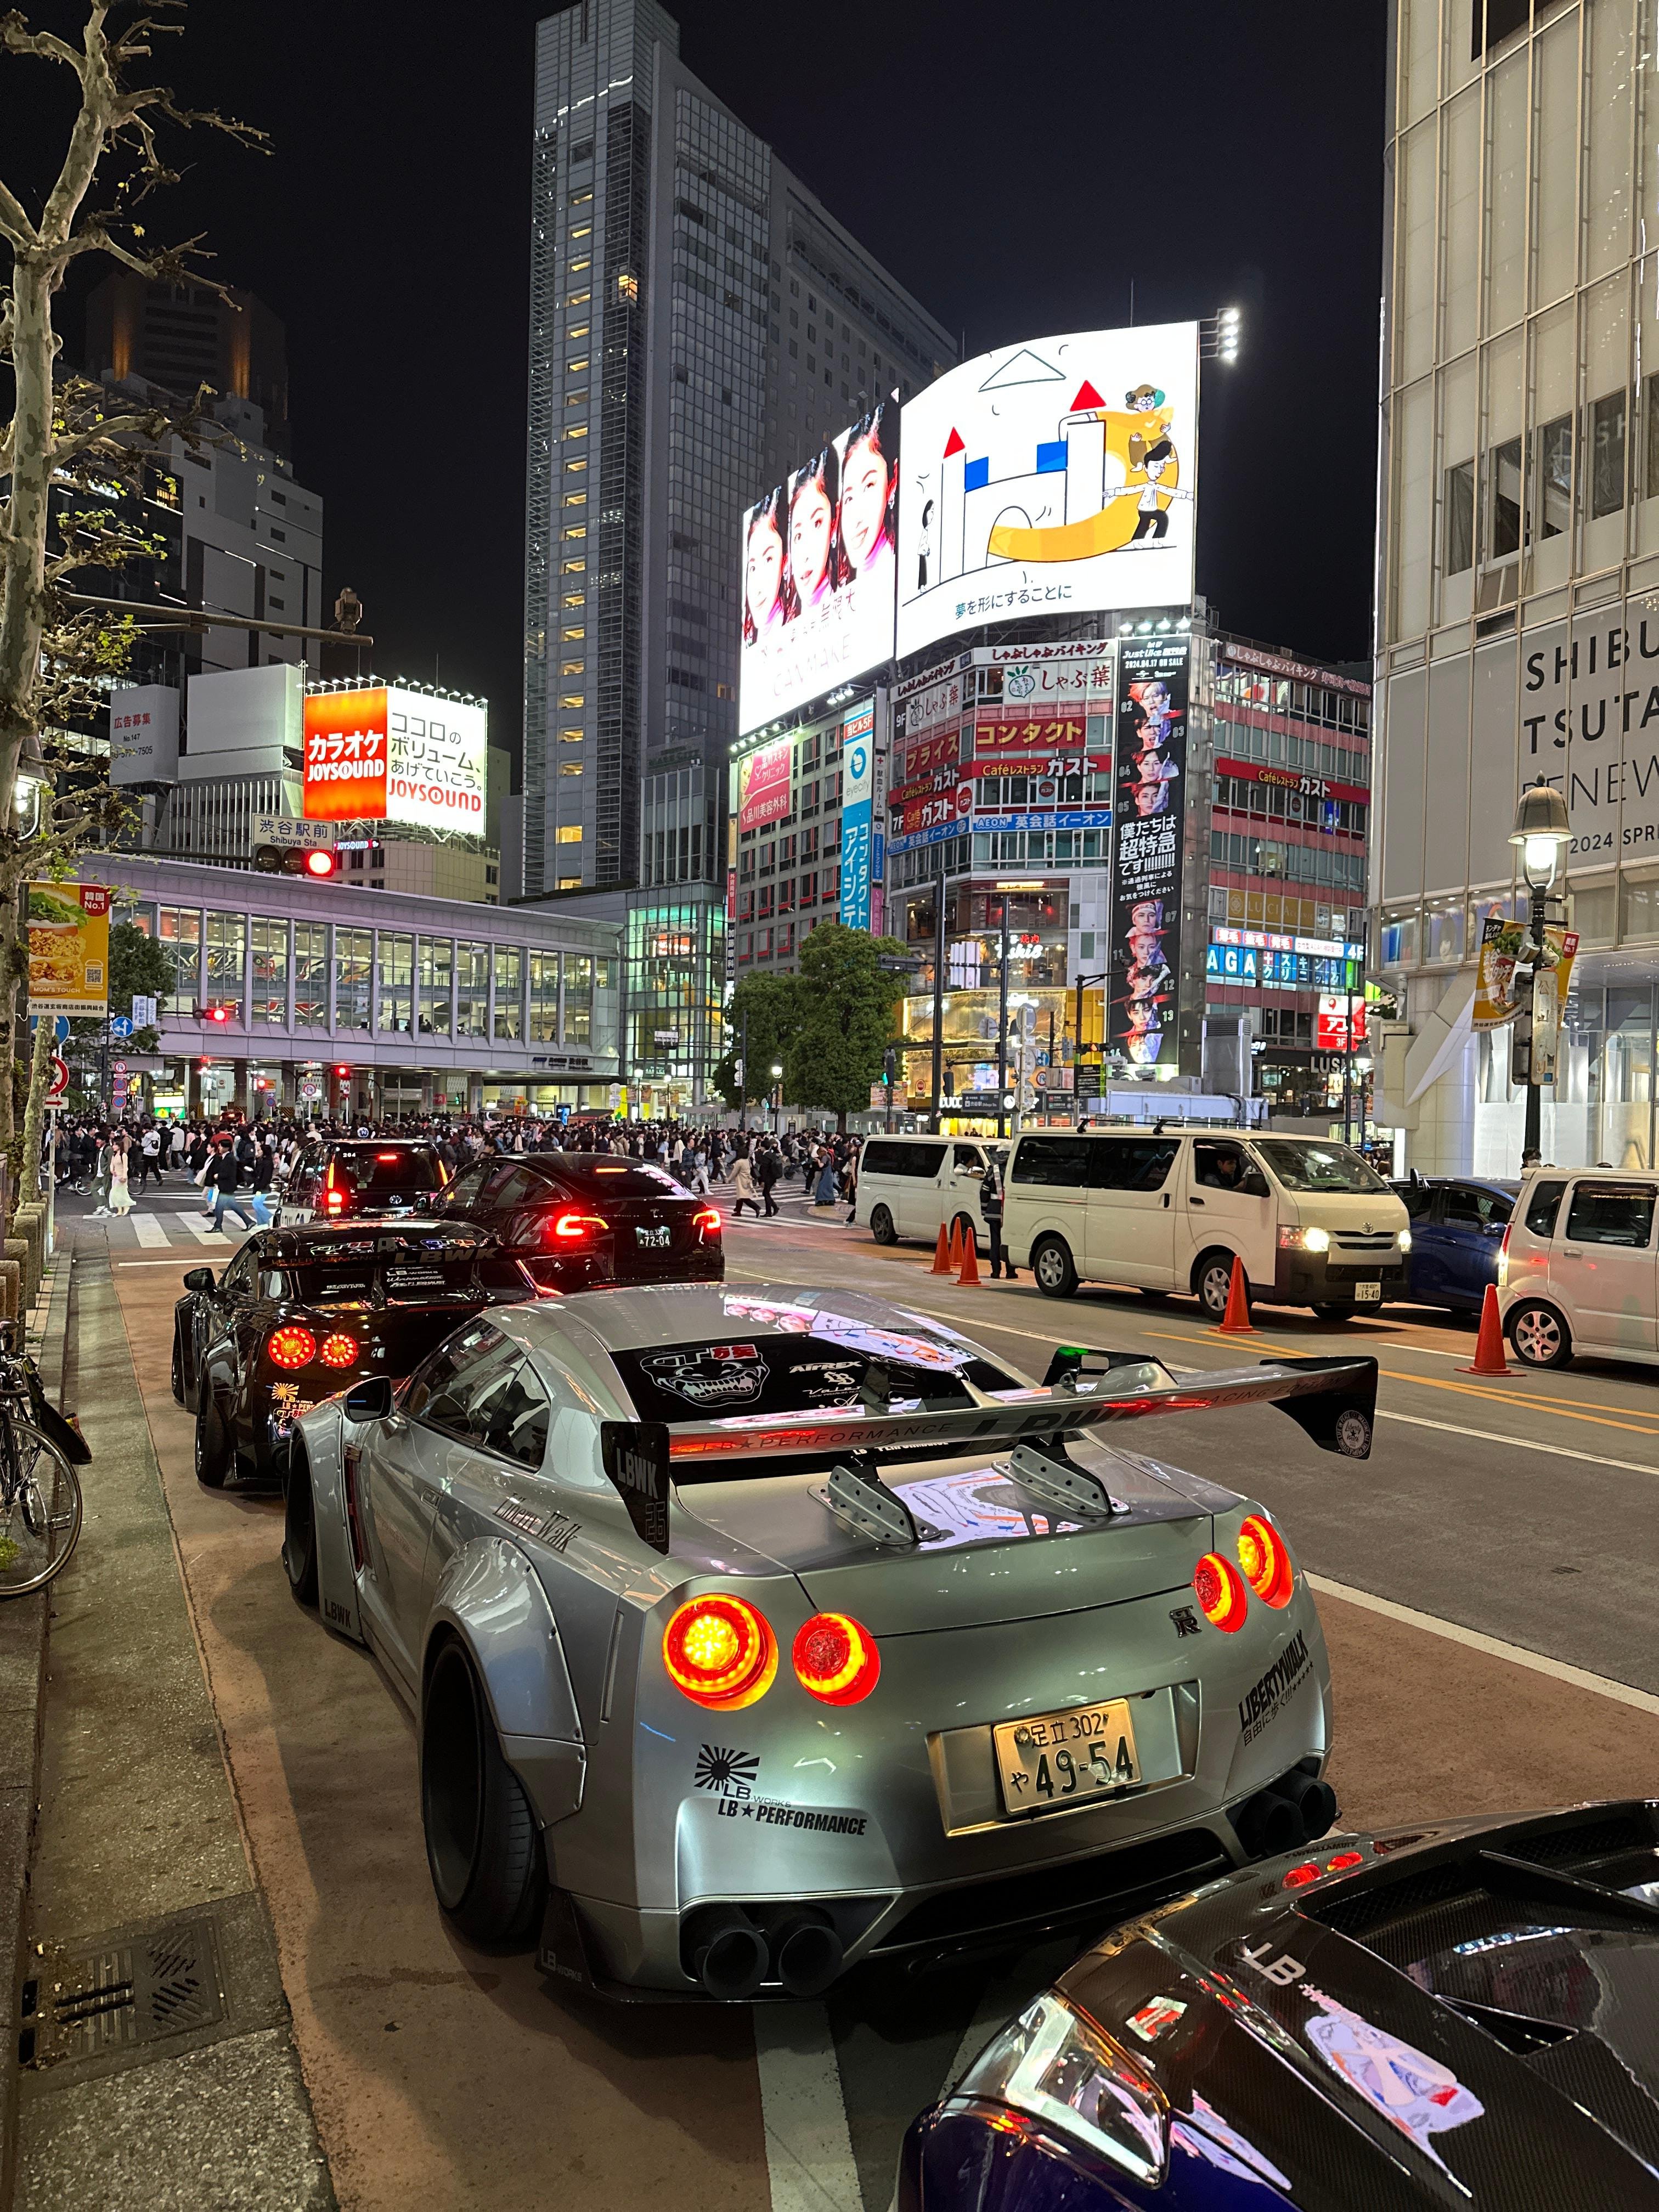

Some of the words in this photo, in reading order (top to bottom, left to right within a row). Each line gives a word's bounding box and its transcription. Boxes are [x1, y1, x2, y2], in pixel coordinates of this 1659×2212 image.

[956, 585, 1071, 620] 夢を形にすることに
[992, 642, 1109, 661] しゃぶしゃぶバイキング
[1526, 620, 1659, 691] SHIBU
[1125, 659, 1158, 668] 2024.04.17
[1169, 658, 1183, 666] SALE
[1237, 646, 1318, 680] しゃぶしゃぶバイキング
[1042, 664, 1111, 691] しゃぶ葉
[926, 685, 958, 716] しゃぶ葉
[1121, 701, 1133, 713] 02
[114, 713, 151, 729] 広告募集
[392, 712, 461, 745] ココロの
[847, 718, 872, 737] 当ビル5F
[896, 713, 906, 727] 9F
[123, 733, 141, 742] No.147
[977, 721, 1083, 746] コンタクト
[1172, 725, 1184, 738] 03
[308, 730, 384, 762] カラオケ
[391, 736, 481, 773] ボリューム、
[907, 735, 958, 772] プライス
[761, 747, 788, 768] 品川スキン
[1047, 757, 1098, 777] ガスト
[307, 759, 385, 782] JOYSOUND
[391, 759, 482, 791] あげていこう。
[761, 763, 786, 782] クリニック
[933, 768, 960, 793] ガスト
[846, 779, 871, 797] eyecity
[1299, 776, 1331, 798] ガスト
[1523, 755, 1659, 810] NEW
[388, 778, 482, 812] JOYSOUND
[746, 793, 787, 823] 品川美容外科
[906, 809, 921, 822] Café
[921, 798, 954, 828] ガスト
[260, 819, 328, 838] 渋谷駅前
[893, 814, 904, 831] 7F
[977, 816, 1008, 828] AEON
[1015, 813, 1109, 830] 英会話イーオン
[1120, 814, 1177, 840] 僕たちは
[270, 836, 301, 846] Shibuya
[336, 840, 369, 850] JOYSOUND
[909, 825, 956, 849] 英会話イーオン
[1119, 831, 1176, 862] 超特急
[1570, 832, 1613, 854] 2024
[843, 826, 858, 931] アイシテ
[858, 823, 869, 931] コンタクト
[1119, 886, 1174, 901] お気をつけください
[84, 901, 105, 910] No.1
[1318, 914, 1328, 927] 5F
[1347, 944, 1364, 960] 4F
[1564, 944, 1575, 953] No.1
[1206, 949, 1256, 974] AGA
[1163, 979, 1175, 991] 12
[1162, 1010, 1174, 1022] 13
[1327, 1017, 1355, 1032] アコ
[1336, 1037, 1346, 1047] 3F
[645, 1235, 670, 1247] 72-04
[290, 1255, 383, 1264] PERFORMANCE
[394, 1247, 499, 1264] LBWK
[1361, 1290, 1379, 1300] 15-40
[759, 1422, 952, 1449] PERFORMANCE
[1196, 1384, 1273, 1406] RACING
[1275, 1375, 1344, 1397] EDITION
[616, 1447, 659, 1500] LBWK
[535, 1512, 583, 1554] Walk
[324, 1598, 352, 1629] LBWK
[1238, 1629, 1309, 1733] LIBERTYWALK
[1030, 1720, 1069, 1748] 足立
[1070, 1712, 1105, 1739] 302
[1011, 1771, 1029, 1793] や
[1036, 1735, 1134, 1798] 49-54
[718, 1798, 738, 1818] LB
[755, 1804, 867, 1836] PERFORMANCE
[1241, 1942, 1307, 1986] LB
